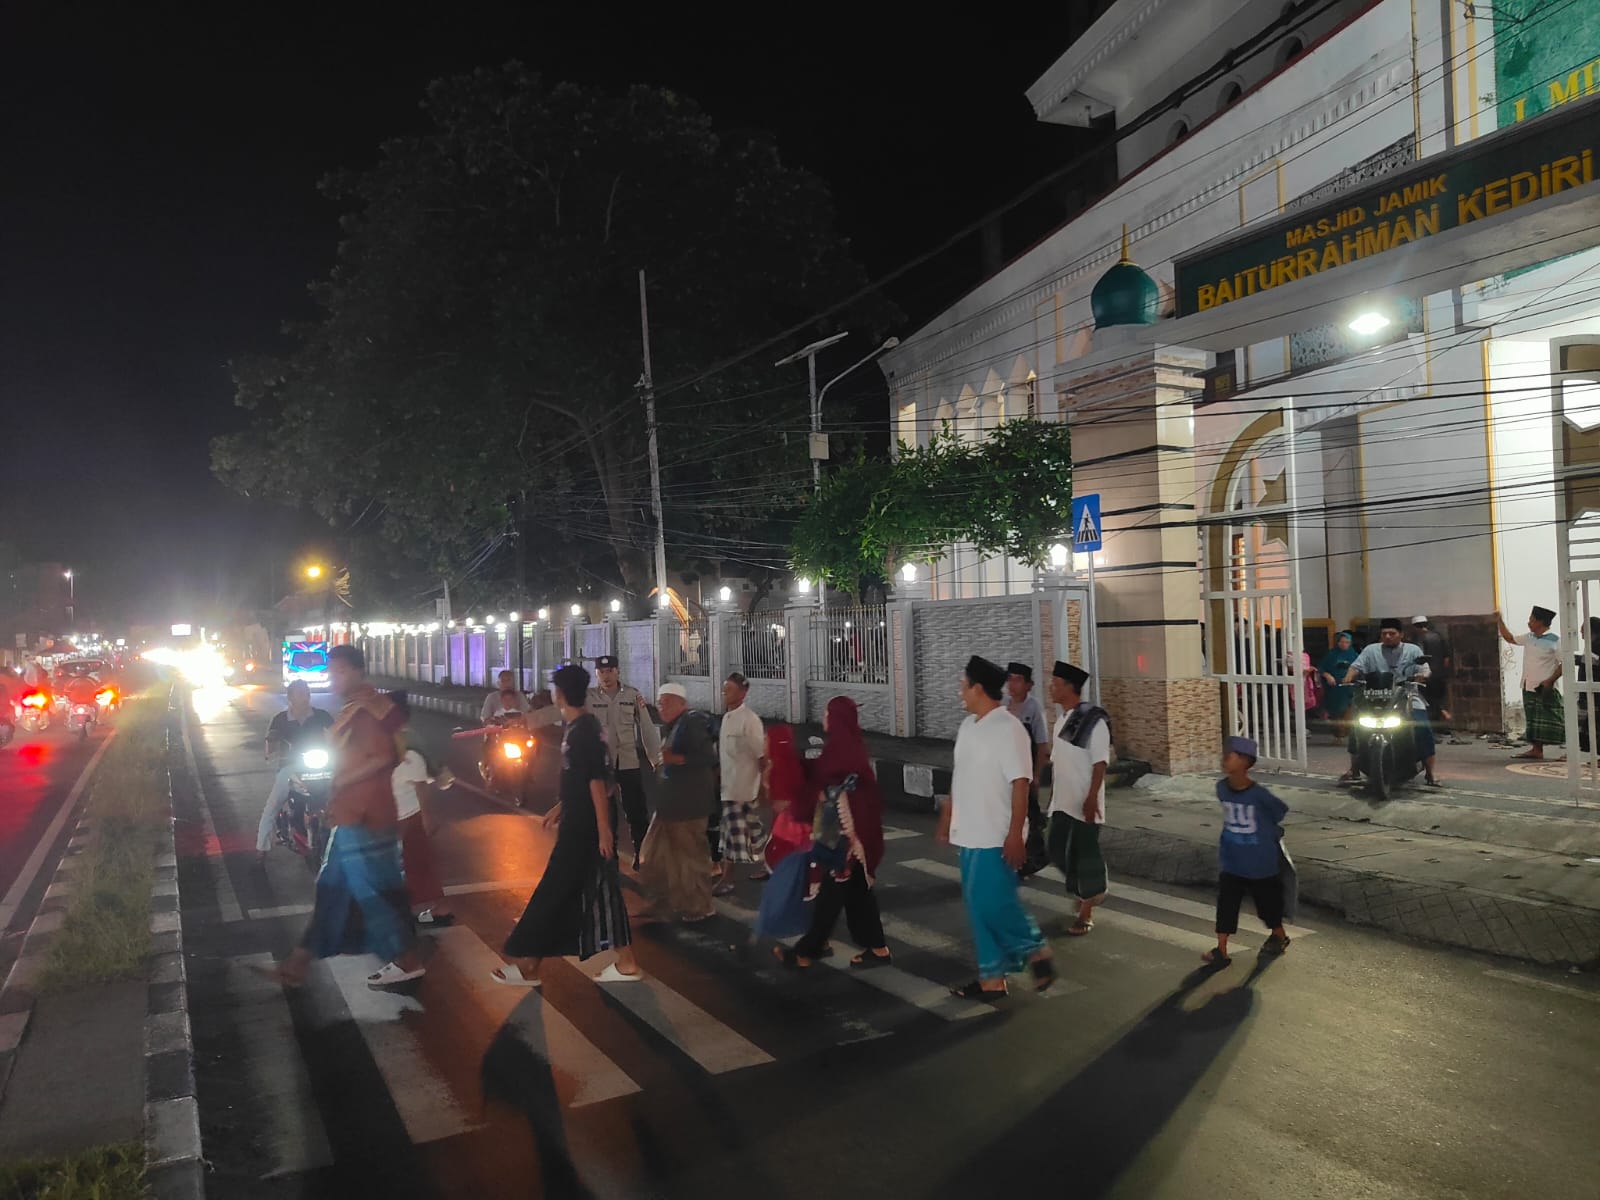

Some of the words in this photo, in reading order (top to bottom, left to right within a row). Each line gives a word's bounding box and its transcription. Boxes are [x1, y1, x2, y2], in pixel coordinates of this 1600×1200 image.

[1197, 202, 1440, 312] BAITURRAHMAN
[1457, 148, 1593, 225] KEDIRI
[1285, 206, 1366, 248] MASJID
[1374, 173, 1448, 217] JAMIK
